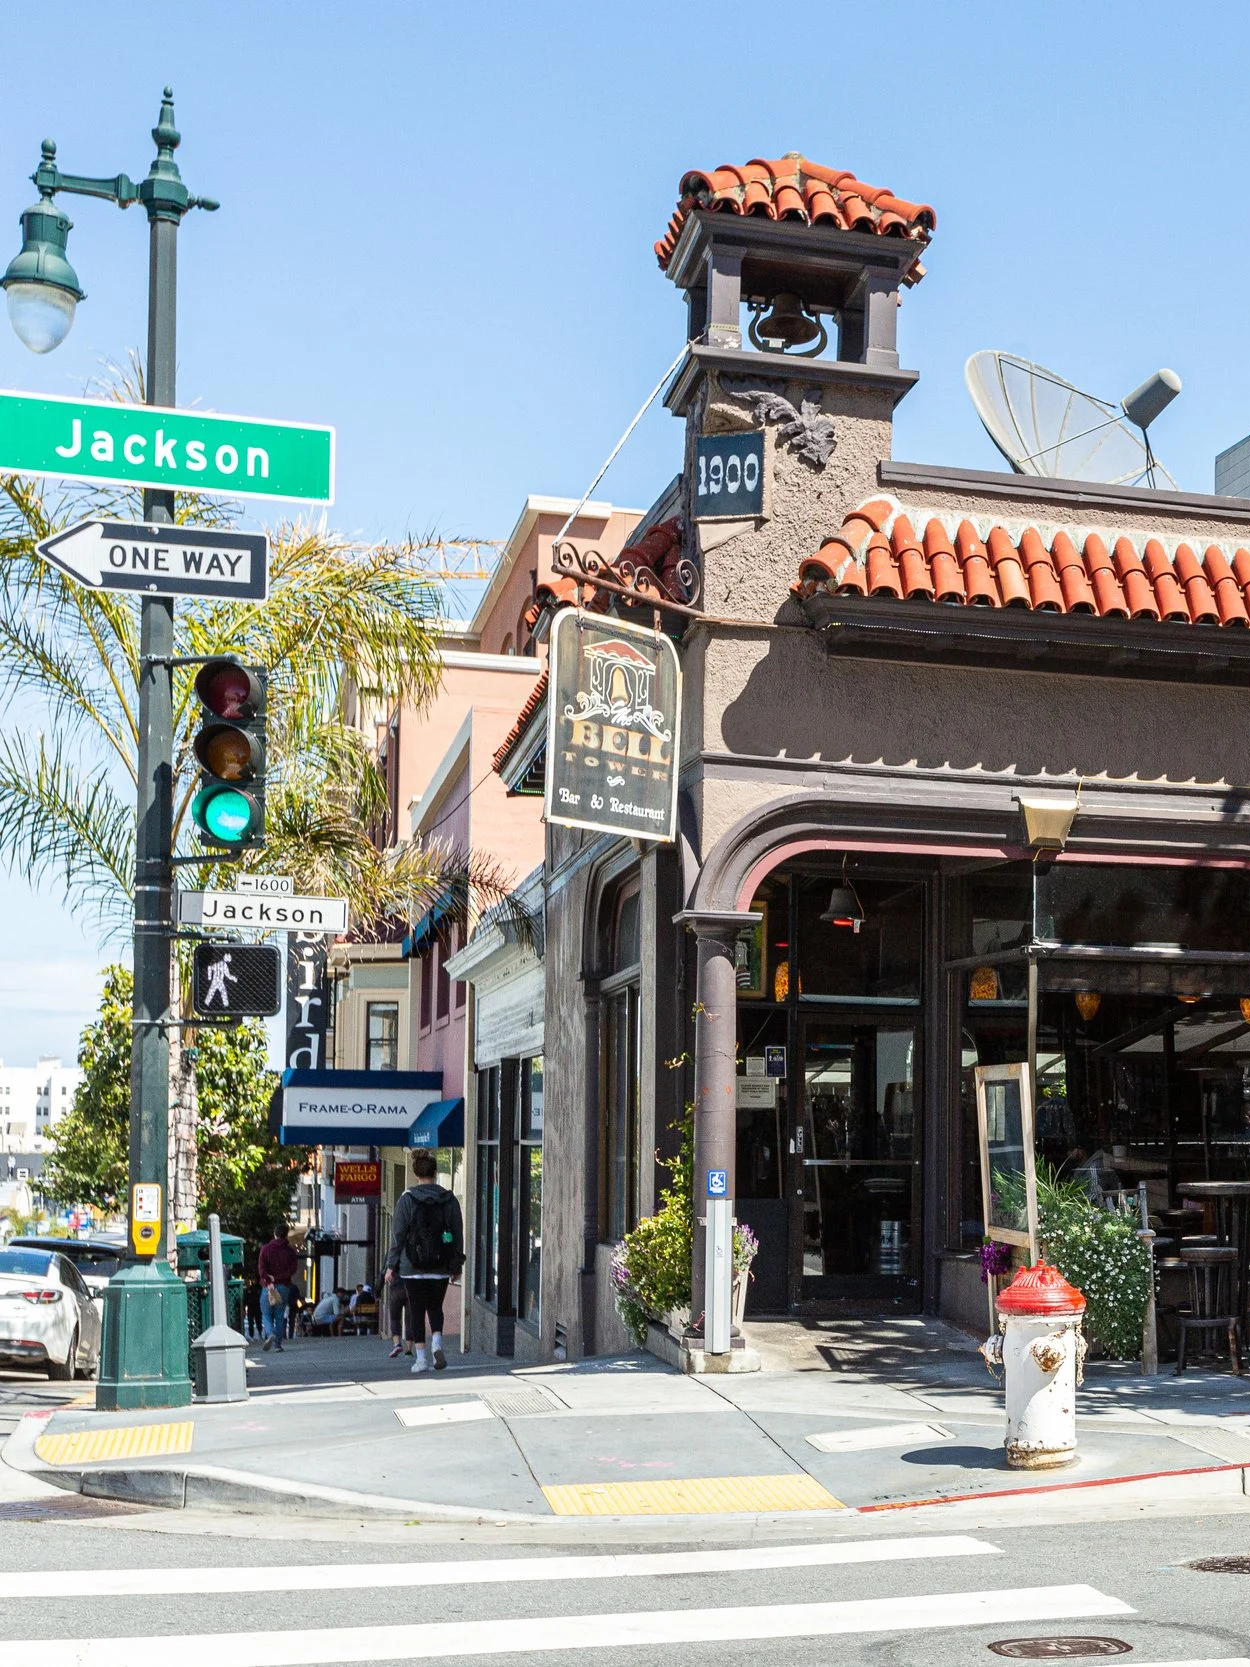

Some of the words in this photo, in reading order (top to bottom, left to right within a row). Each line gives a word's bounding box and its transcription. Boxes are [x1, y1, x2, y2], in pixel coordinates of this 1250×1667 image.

[55, 418, 270, 479] Jackson
[698, 453, 760, 496] 1900
[109, 544, 170, 572] ONE
[183, 551, 244, 578] WAY
[610, 700, 635, 727] The
[571, 719, 672, 766] BELL
[560, 750, 669, 782] TOWER
[558, 787, 581, 805] Bar
[590, 794, 604, 810] &
[609, 797, 666, 820] Restaurant
[255, 878, 290, 892] 1600
[203, 900, 323, 924] Jackson
[298, 1101, 409, 1115] FRAME-O-RAMA
[338, 1164, 377, 1173] WELLS
[340, 1173, 377, 1182] FARGO
[350, 1196, 366, 1204] ATM
